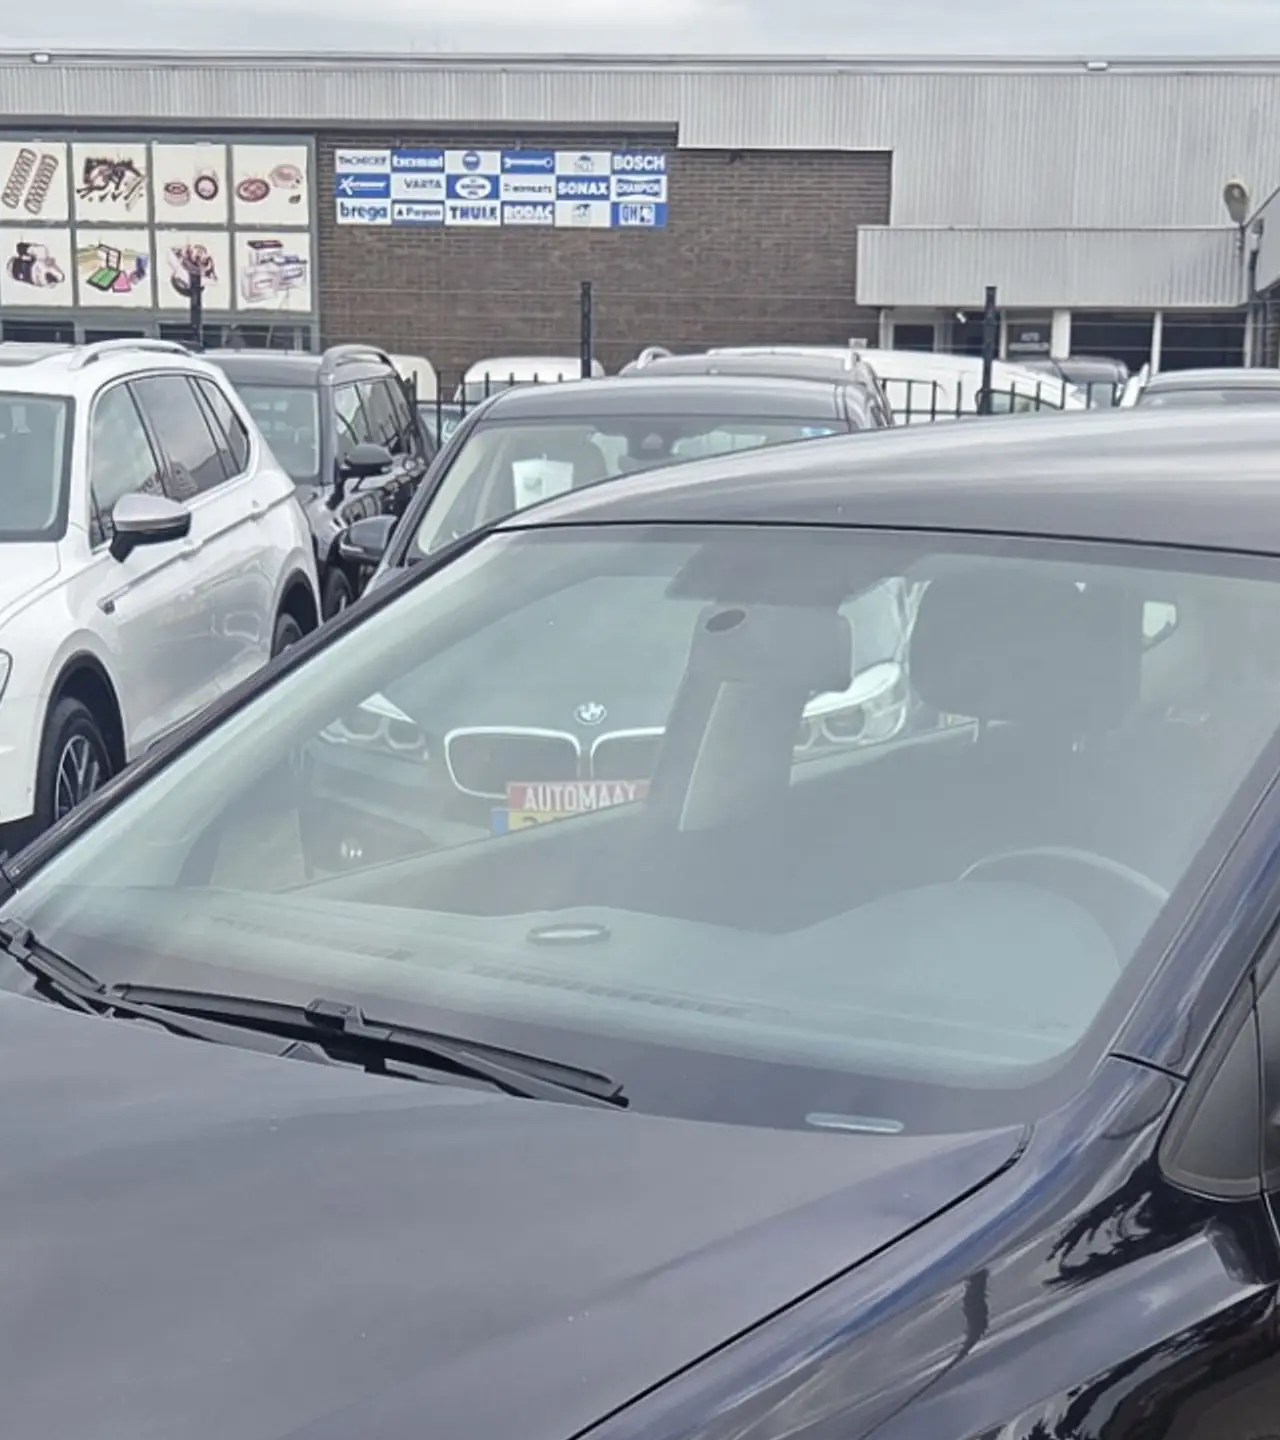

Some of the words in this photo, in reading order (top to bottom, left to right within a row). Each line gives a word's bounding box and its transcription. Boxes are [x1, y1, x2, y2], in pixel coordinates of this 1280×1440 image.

[613, 155, 665, 171] BOSCH
[404, 178, 442, 189] VARTA
[557, 180, 609, 196] SONAX
[448, 206, 498, 220] THULE
